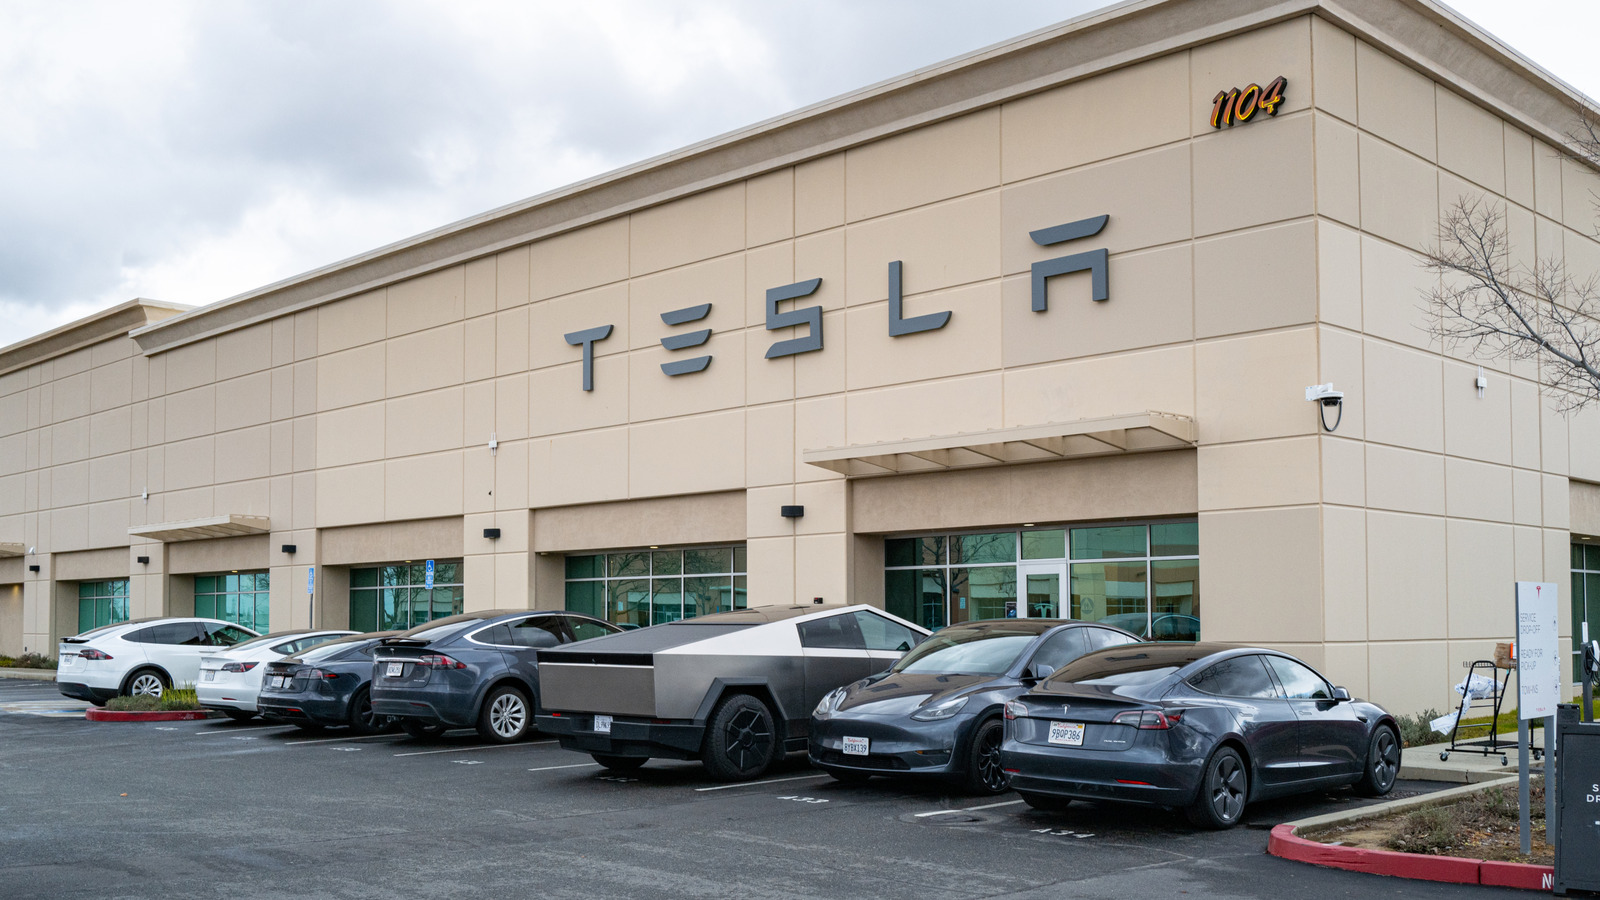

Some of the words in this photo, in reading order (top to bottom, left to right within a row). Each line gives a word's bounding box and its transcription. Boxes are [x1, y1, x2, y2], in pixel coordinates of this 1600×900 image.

[1210, 75, 1287, 129] 1104
[564, 214, 1110, 392] TESLA
[1520, 613, 1536, 623] SERVICE
[1520, 625, 1541, 635] DROP-OFF
[1521, 648, 1533, 659] READY
[1534, 648, 1544, 658] FOR
[1521, 661, 1536, 671] PICK-UP
[1521, 684, 1539, 695] TOW-INS
[1542, 872, 1555, 889] N
